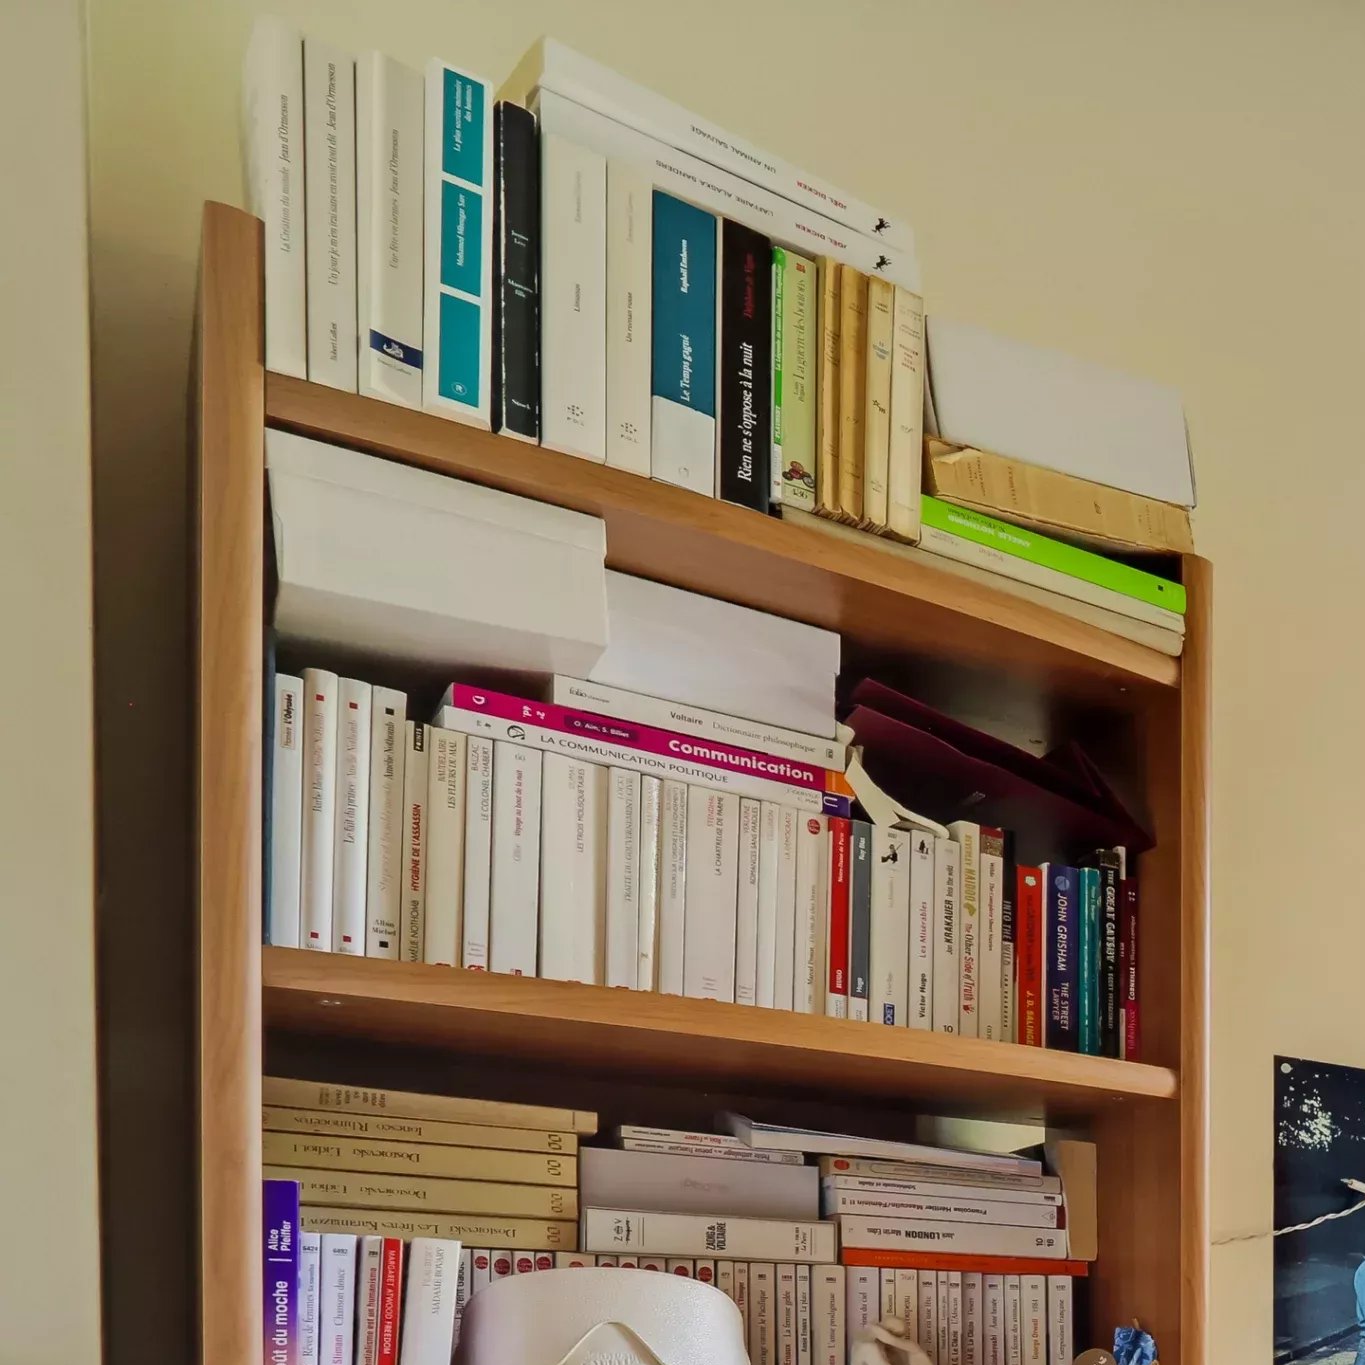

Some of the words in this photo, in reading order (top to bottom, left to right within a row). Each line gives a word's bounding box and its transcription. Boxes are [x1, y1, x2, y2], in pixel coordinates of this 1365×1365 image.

[796, 180, 828, 201] DICKER
[681, 334, 693, 361] gagné
[739, 342, 753, 365] nuit
[680, 361, 692, 388] Temps
[739, 366, 752, 379] la
[739, 380, 752, 390] à
[680, 388, 691, 402] Le
[738, 391, 757, 438] s'oppose
[740, 438, 752, 453] ne
[737, 454, 752, 482] Rien
[670, 710, 704, 726] Voltaire
[540, 734, 556, 747] LA
[558, 737, 666, 769] COMMUNICATION
[668, 763, 729, 784] POLITIQUE
[668, 738, 814, 782] Communication
[412, 803, 422, 847] L'ASSASSIN
[411, 848, 420, 858] DE
[1057, 893, 1068, 922] JOHN
[1105, 885, 1116, 920] GREAT
[1057, 925, 1068, 972] GRISHAM
[1060, 982, 1069, 996] THE
[1052, 988, 1060, 1021] LAWYER
[1060, 998, 1069, 1031] STREET
[943, 1025, 953, 1034] 10
[267, 1228, 279, 1251] Alice
[706, 1231, 716, 1250] ZADIG
[716, 1222, 727, 1250] VOLTAIRE
[272, 1281, 289, 1324] moche
[272, 1326, 288, 1347] du
[384, 1323, 393, 1355] FREEDOM
